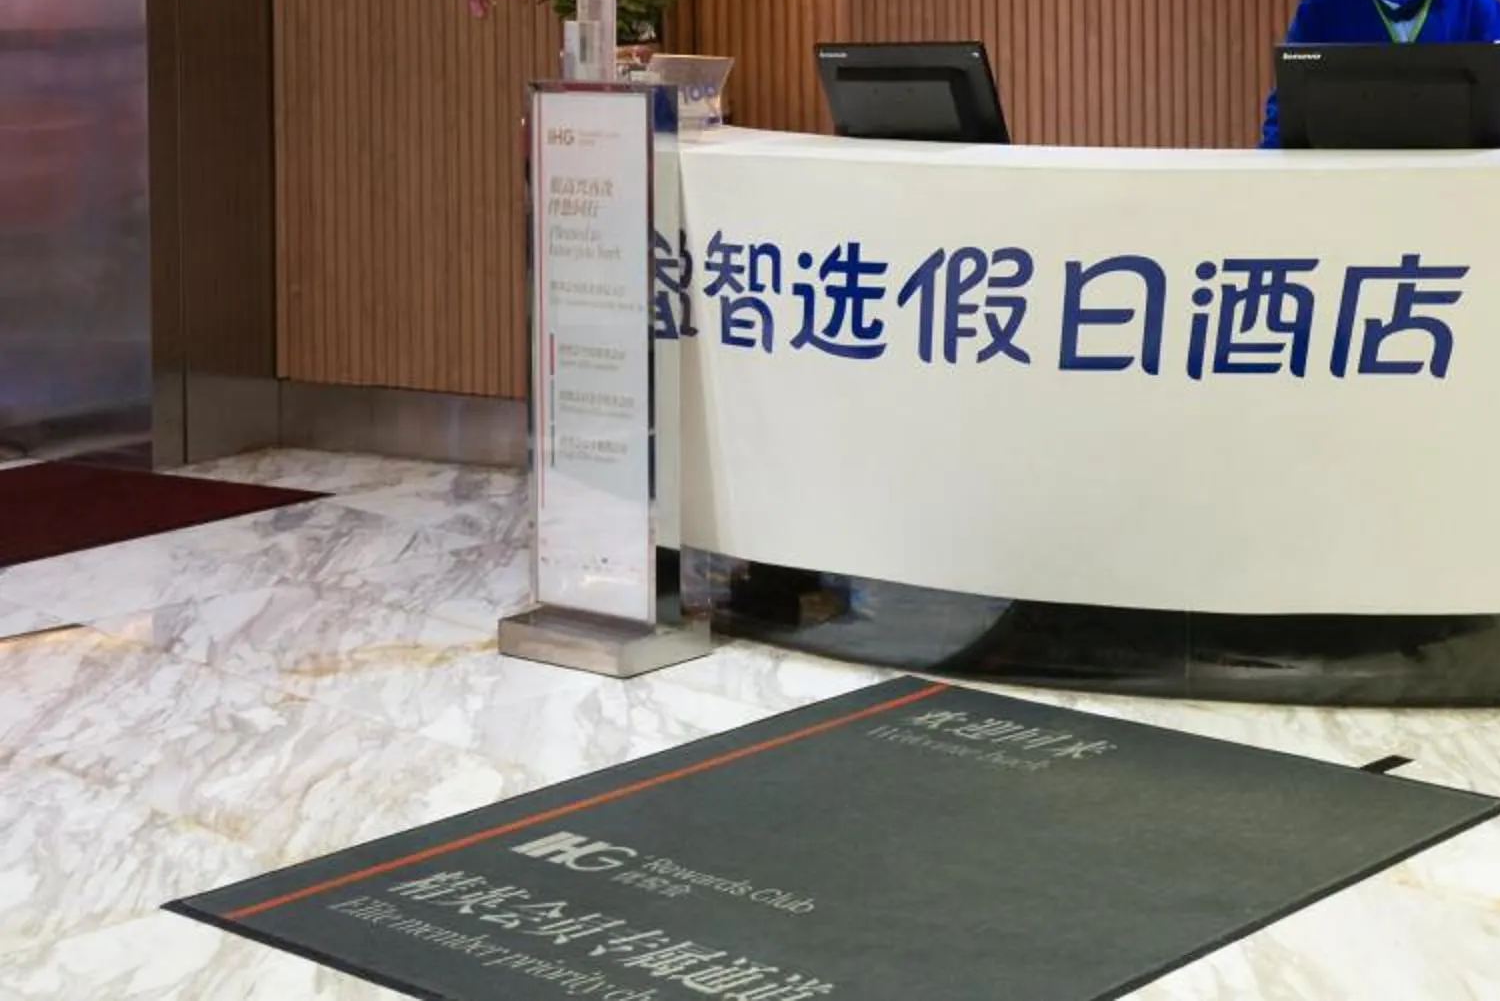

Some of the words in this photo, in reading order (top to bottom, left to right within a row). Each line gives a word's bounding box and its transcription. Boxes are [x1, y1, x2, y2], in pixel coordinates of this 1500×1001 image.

[508, 831, 634, 873] IHG
[645, 857, 752, 896] Rewards
[750, 887, 815, 915] Club
[387, 870, 834, 1001] 精英会员专属通道
[387, 915, 511, 958] member
[480, 948, 616, 996] priority
